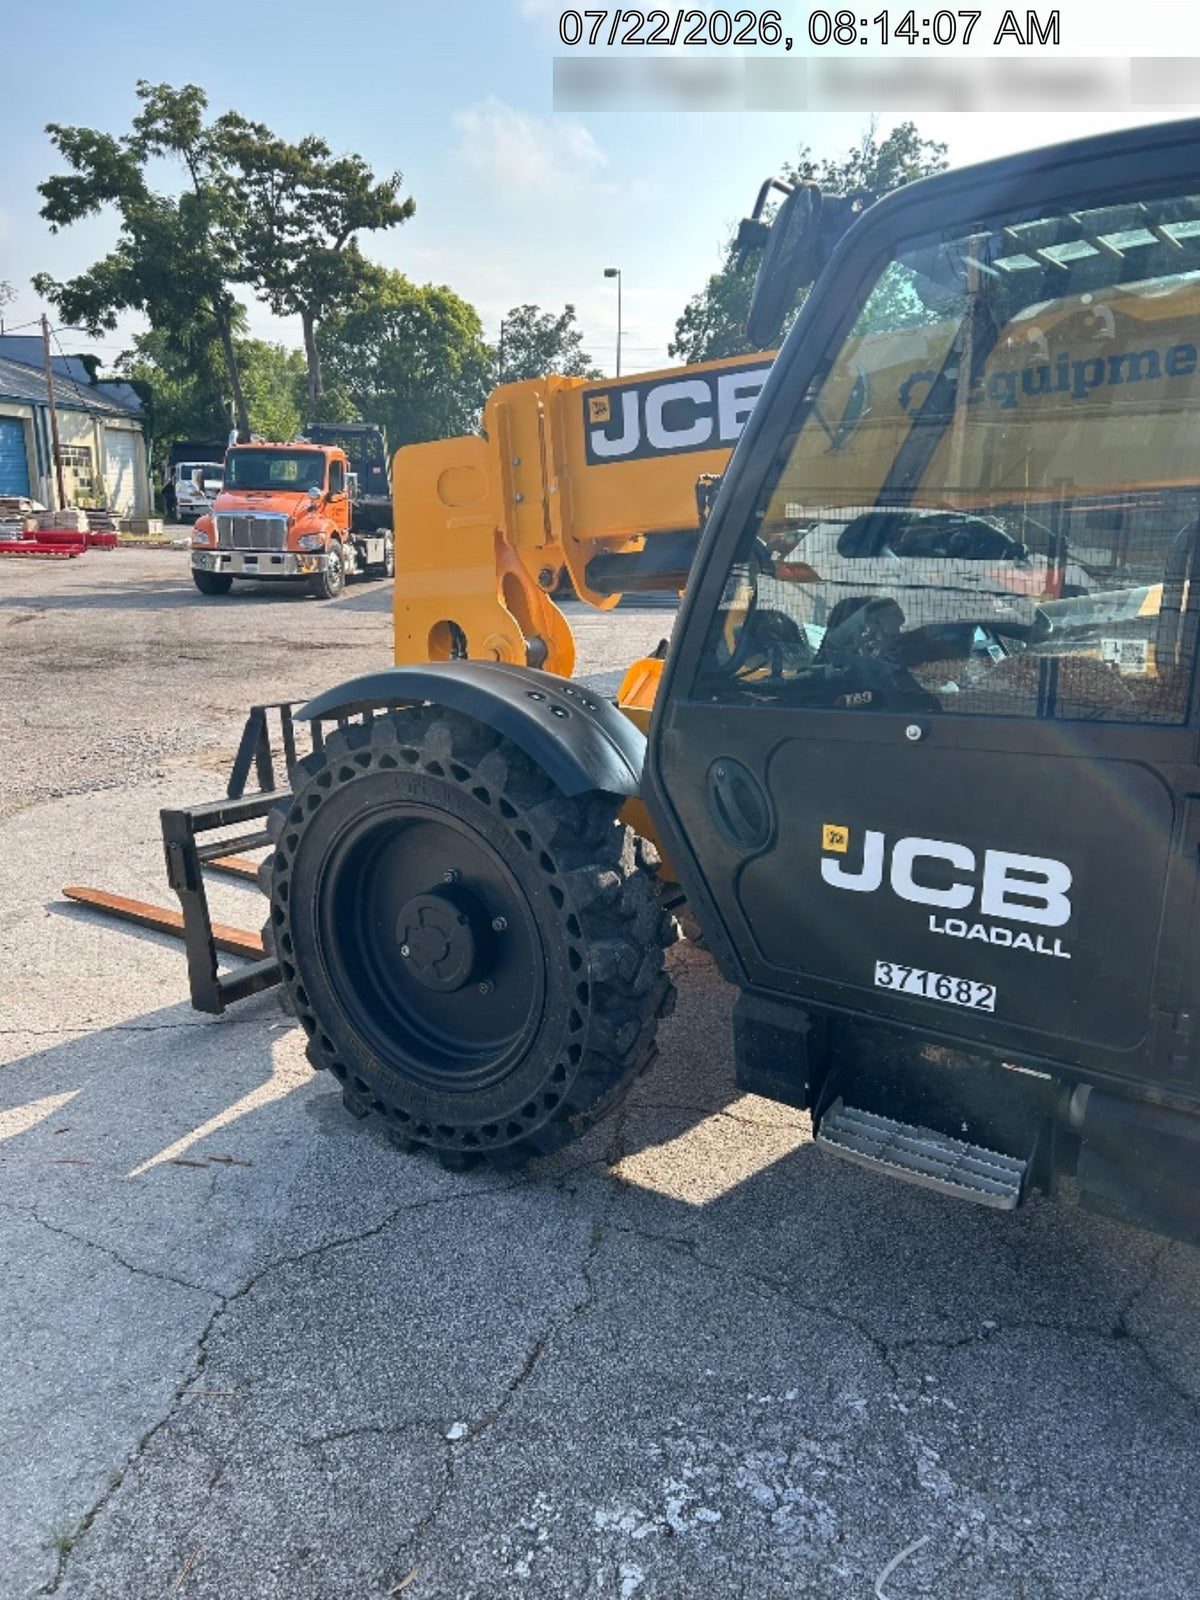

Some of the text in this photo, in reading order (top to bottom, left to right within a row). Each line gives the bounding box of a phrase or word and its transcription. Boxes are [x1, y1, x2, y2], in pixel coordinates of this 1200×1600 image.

[820, 829, 1073, 927] JCB
[928, 914, 1072, 959] LOADALL
[877, 962, 995, 1010] 371682
